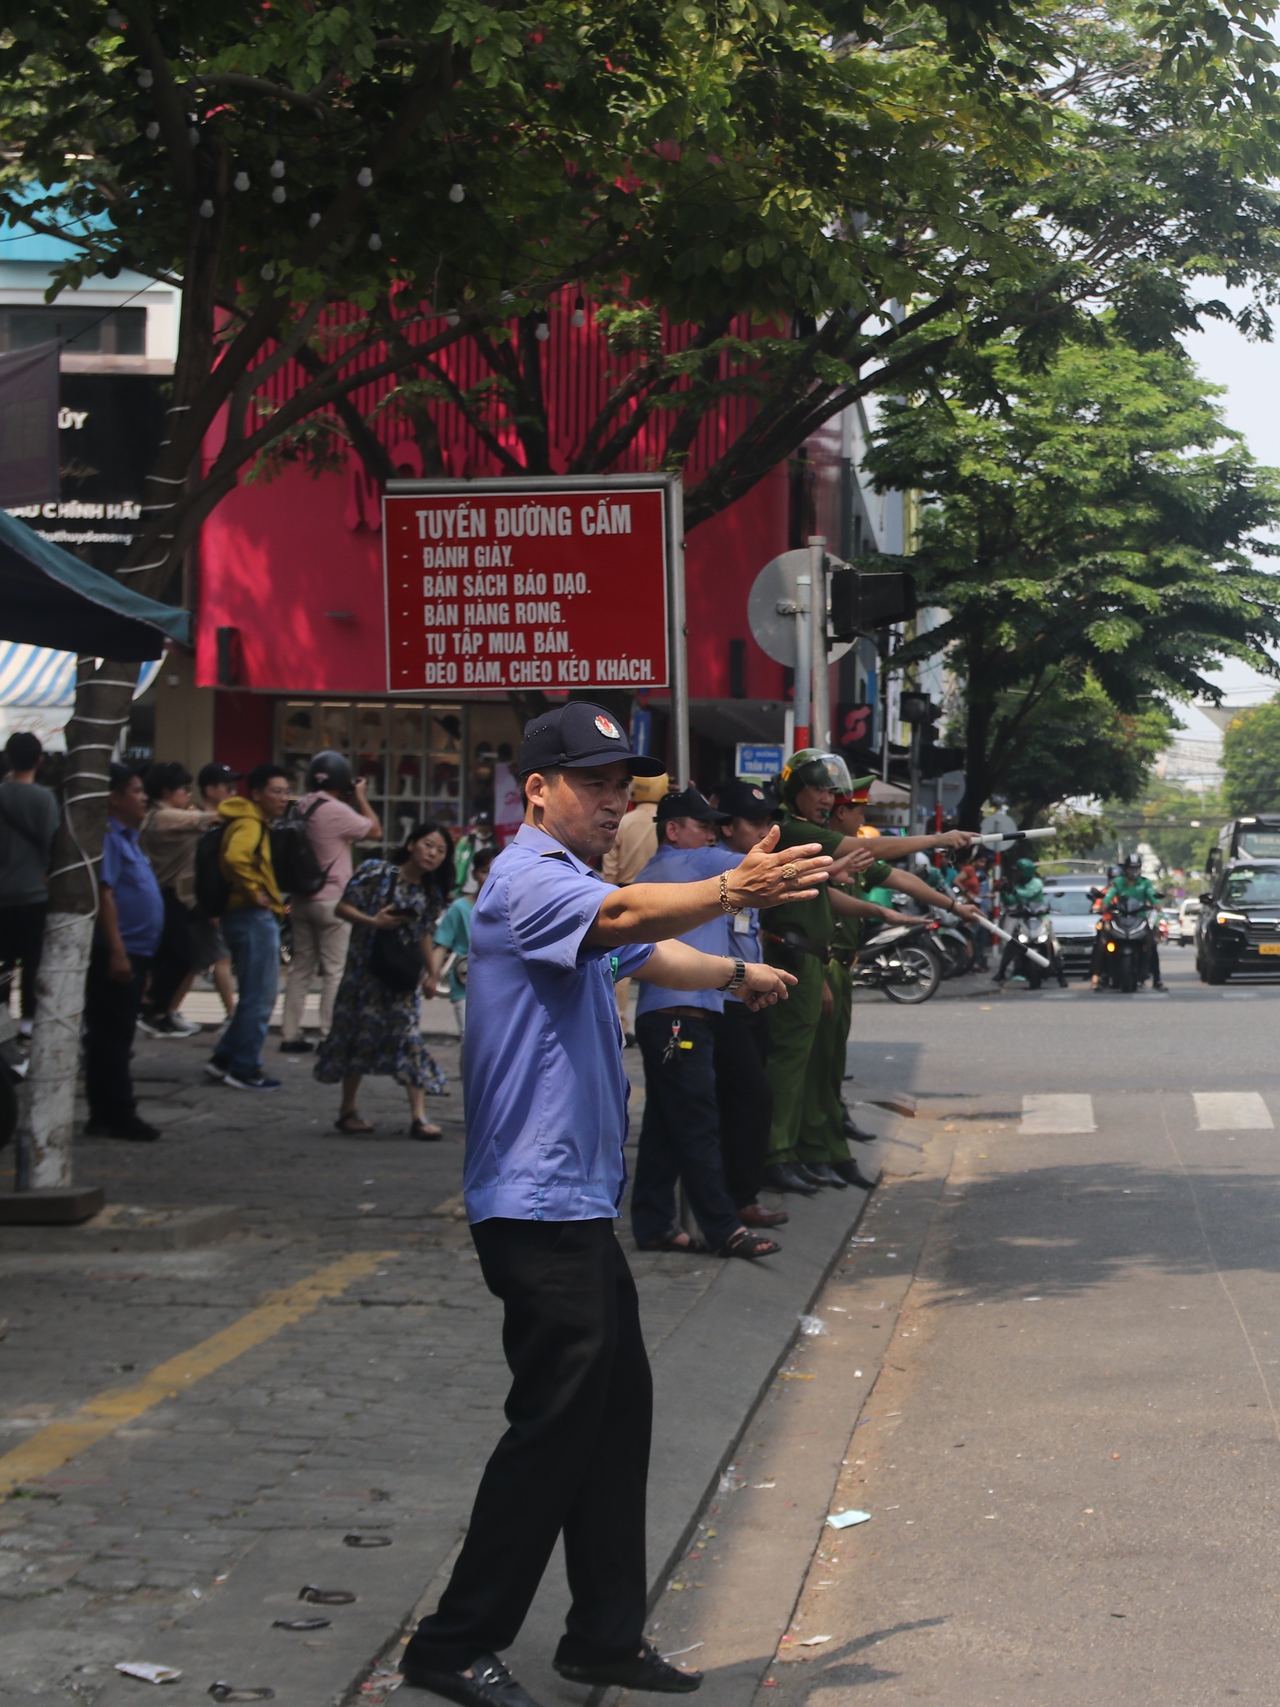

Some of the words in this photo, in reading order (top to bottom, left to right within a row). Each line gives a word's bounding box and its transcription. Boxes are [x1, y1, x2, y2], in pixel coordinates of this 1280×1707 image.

[42, 499, 104, 519] CHÍNH
[415, 501, 486, 539] TUYẾN
[494, 500, 572, 538] ĐƯỜNG
[580, 497, 632, 536] CẤM
[422, 541, 469, 568] ĐÁNH
[474, 540, 514, 568] GIÀY.
[423, 570, 458, 598] BÁN
[463, 569, 508, 597] SÁCH
[513, 568, 547, 596] BÁO
[553, 571, 592, 600] DẠO.
[424, 599, 459, 627] BÁN
[464, 598, 510, 626] HÀNG
[515, 601, 566, 625] RONG.
[425, 632, 446, 660] TỤ
[452, 627, 484, 660] TẬP
[488, 632, 527, 655] MUA
[533, 626, 574, 654] BÁN.
[463, 655, 507, 686] BÁM,
[509, 655, 552, 683] CHÈO
[558, 654, 590, 682] KÉO
[596, 653, 656, 681] KHÁCH.
